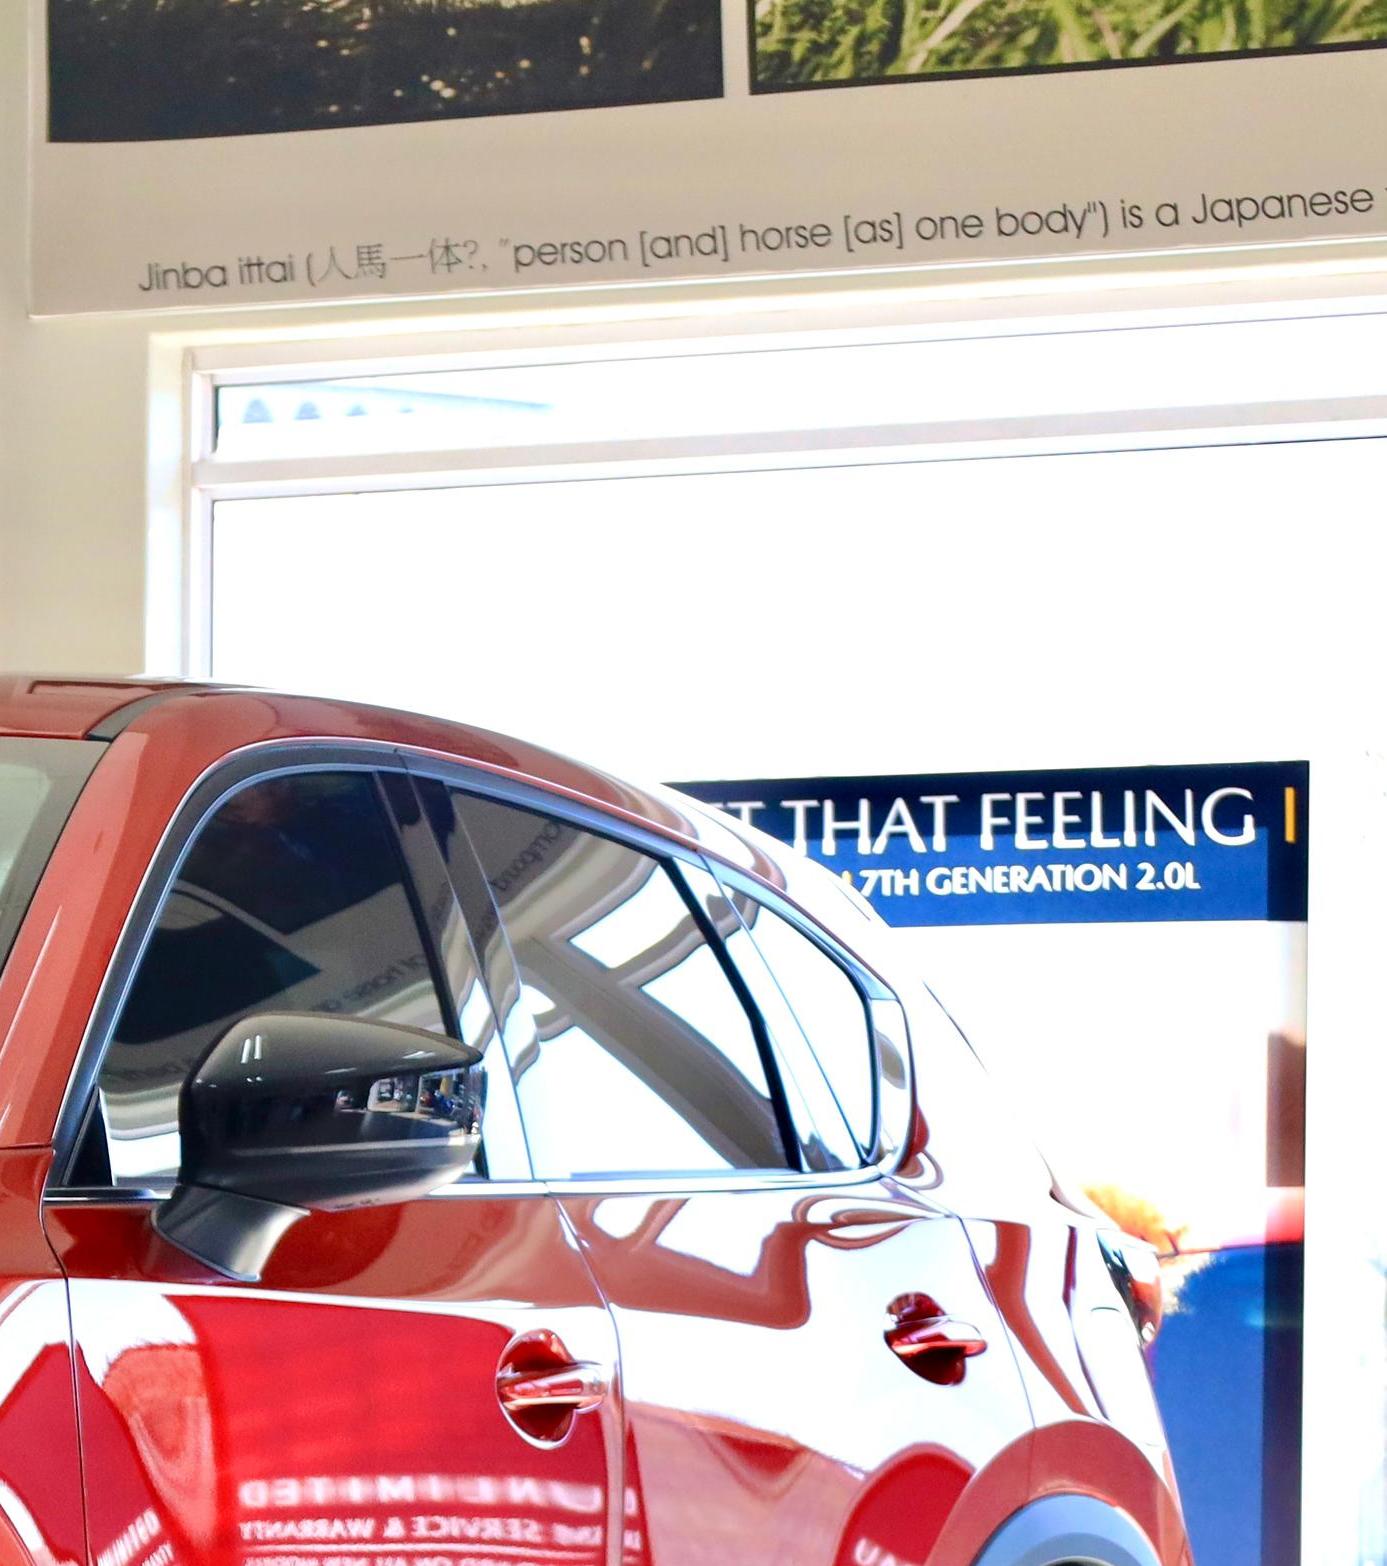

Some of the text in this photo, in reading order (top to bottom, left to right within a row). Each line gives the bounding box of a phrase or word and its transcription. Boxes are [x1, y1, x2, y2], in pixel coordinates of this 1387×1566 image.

[138, 261, 228, 292] Jinba
[237, 253, 297, 286] ittai
[639, 223, 729, 267] [and]
[739, 222, 833, 252] horse
[843, 211, 904, 252] [as]
[914, 213, 985, 242] one
[995, 199, 1110, 241] body")
[1119, 198, 1145, 230] is
[1155, 203, 1181, 229] a
[1191, 187, 1375, 228] Japanese
[779, 793, 961, 857] THAT
[980, 784, 1258, 853] FEELING
[858, 861, 1201, 898] 7TH GENERATION 2.0L
